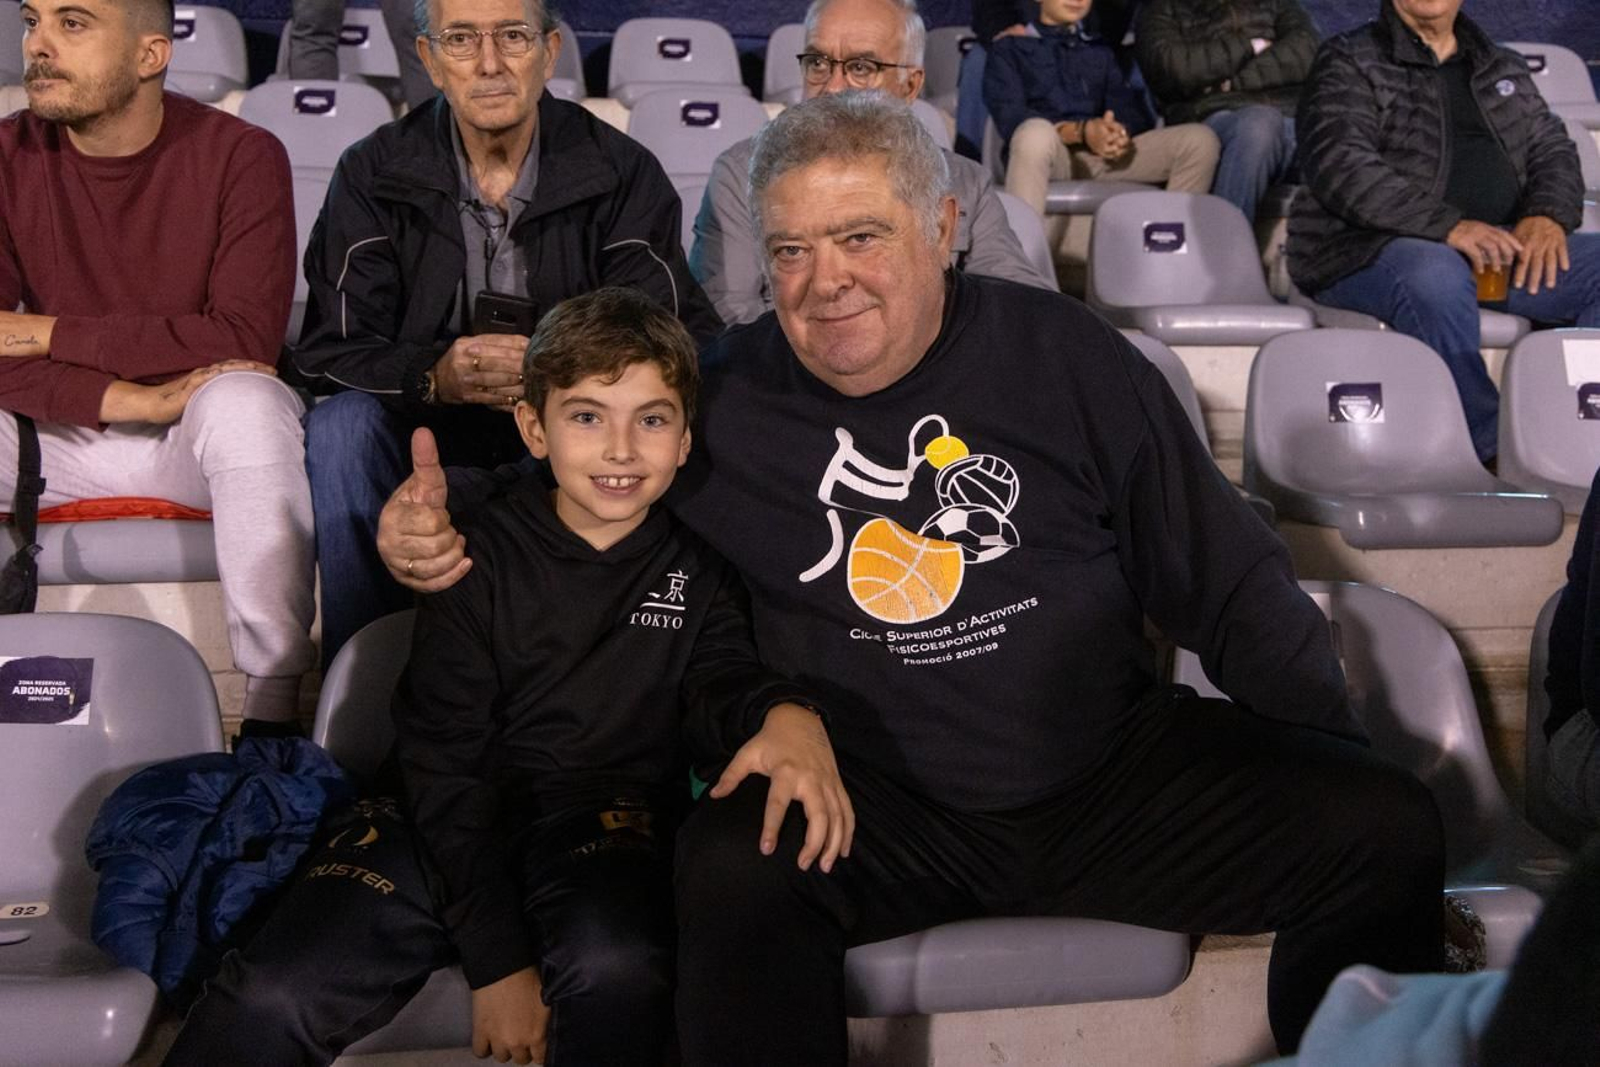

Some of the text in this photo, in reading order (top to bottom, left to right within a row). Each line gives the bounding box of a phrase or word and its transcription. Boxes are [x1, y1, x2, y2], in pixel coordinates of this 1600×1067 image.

[629, 612, 683, 630] TOKYO
[886, 626, 953, 642] SUPERIOR
[957, 597, 1039, 632] D'ACTIVITATS
[887, 623, 1007, 654] FISICOESPORTIVES
[903, 642, 999, 666] PROMOCIÓ 2007/09
[12, 686, 71, 695] ABONADOS
[11, 906, 37, 916] 82
